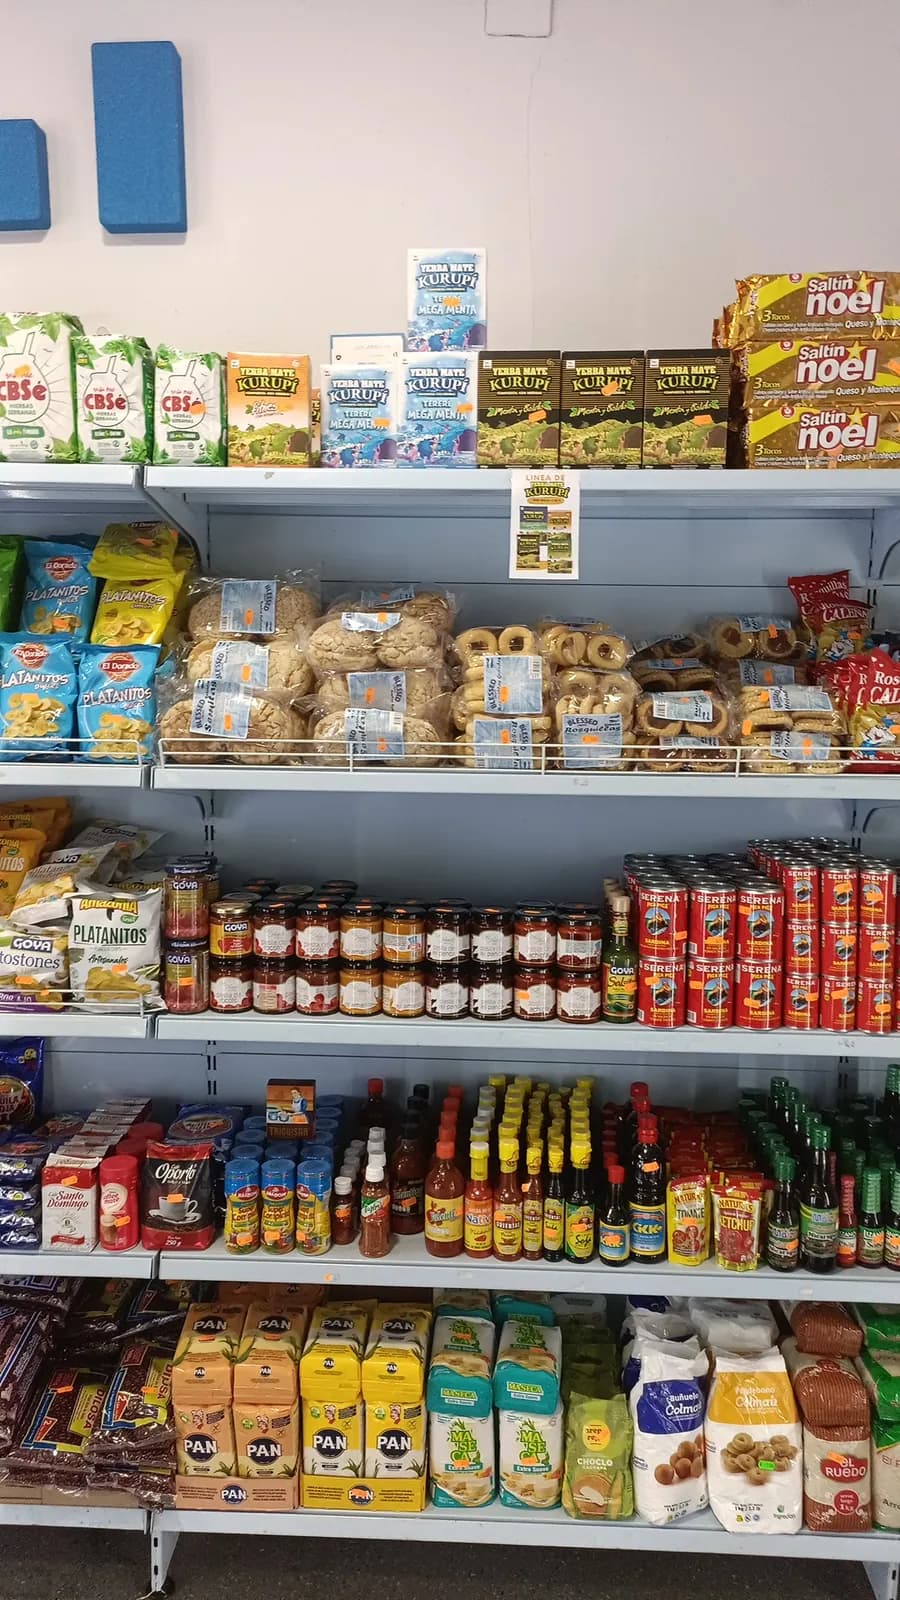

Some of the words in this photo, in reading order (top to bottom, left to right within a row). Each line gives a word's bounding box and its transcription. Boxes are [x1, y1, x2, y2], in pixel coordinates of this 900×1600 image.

[420, 264, 448, 272] YERBA
[450, 263, 474, 272] MATE
[416, 273, 478, 288] KURUPÍ
[808, 276, 853, 292] Saltín
[806, 280, 884, 316] noel
[418, 305, 444, 316] MEGA
[446, 304, 477, 315] MENTA
[762, 310, 771, 322] 3
[845, 320, 868, 328] Queso
[799, 342, 844, 360] Saltín
[660, 366, 690, 375] YERBA
[690, 366, 716, 375] MATE
[796, 349, 877, 382] noel
[409, 368, 438, 377] YERBA
[440, 368, 466, 377] MATE
[492, 367, 522, 376] YERBA
[523, 367, 548, 376] MATE
[576, 366, 606, 376] YERBA
[607, 366, 632, 375] MATE
[238, 376, 299, 393] KURUPÍ
[332, 380, 360, 388] YERBA
[361, 380, 385, 388] MATE
[406, 378, 470, 392] KURUPÍ
[489, 374, 552, 391] KURUPÍ
[656, 374, 718, 391] KURUPÍ
[754, 378, 762, 388] 3
[328, 389, 388, 402] KURUPÍ
[836, 387, 860, 395] Queso
[85, 393, 126, 410] CBSé
[407, 410, 436, 420] MEGA
[800, 410, 846, 427] Saltín
[329, 420, 356, 430] MEGA
[798, 416, 878, 450] noel
[756, 444, 764, 454] 3
[837, 454, 862, 462] Queso
[524, 487, 570, 498] KURUPÍ
[25, 586, 88, 601] PLATANITOS
[102, 662, 110, 670] El
[112, 661, 141, 670] Dorado
[874, 670, 900, 686] Ros
[83, 688, 152, 706] PLATANITOS
[486, 678, 497, 710] BLESSED
[568, 716, 598, 726] BLESSED
[173, 880, 198, 889] GOYA
[640, 893, 680, 902] SERENA
[698, 894, 736, 903] SERENA
[740, 895, 782, 904] SERENA
[224, 923, 248, 931] GOYA
[74, 925, 148, 944] PLATANITOS
[13, 938, 52, 951] GOYA
[168, 956, 192, 964] GOYA
[611, 966, 634, 974] GOYA
[644, 963, 684, 972] SERENA
[696, 964, 734, 972] SERENA
[742, 964, 782, 973] SERENA
[787, 978, 816, 986] SERENA
[155, 1163, 196, 1184] Oporto
[56, 1191, 84, 1200] Santo
[47, 1199, 88, 1211] Domingo
[193, 1320, 228, 1330] PAN
[258, 1320, 292, 1330] PAN
[321, 1319, 354, 1329] PAN
[384, 1320, 415, 1331] PAN
[508, 1382, 542, 1392] MASECA
[442, 1389, 476, 1400] MASECA
[84, 1389, 105, 1429] DILOSA
[451, 1431, 472, 1442] MA
[520, 1432, 541, 1442] MA
[184, 1440, 218, 1453] PAN
[314, 1436, 347, 1450] PAN
[378, 1436, 412, 1450] PAN
[460, 1442, 476, 1452] SE
[528, 1442, 545, 1452] SE
[247, 1444, 282, 1457] PAN
[577, 1458, 613, 1466] CHOCLO
[222, 1490, 247, 1500] PAN
[348, 1491, 374, 1500] PN
